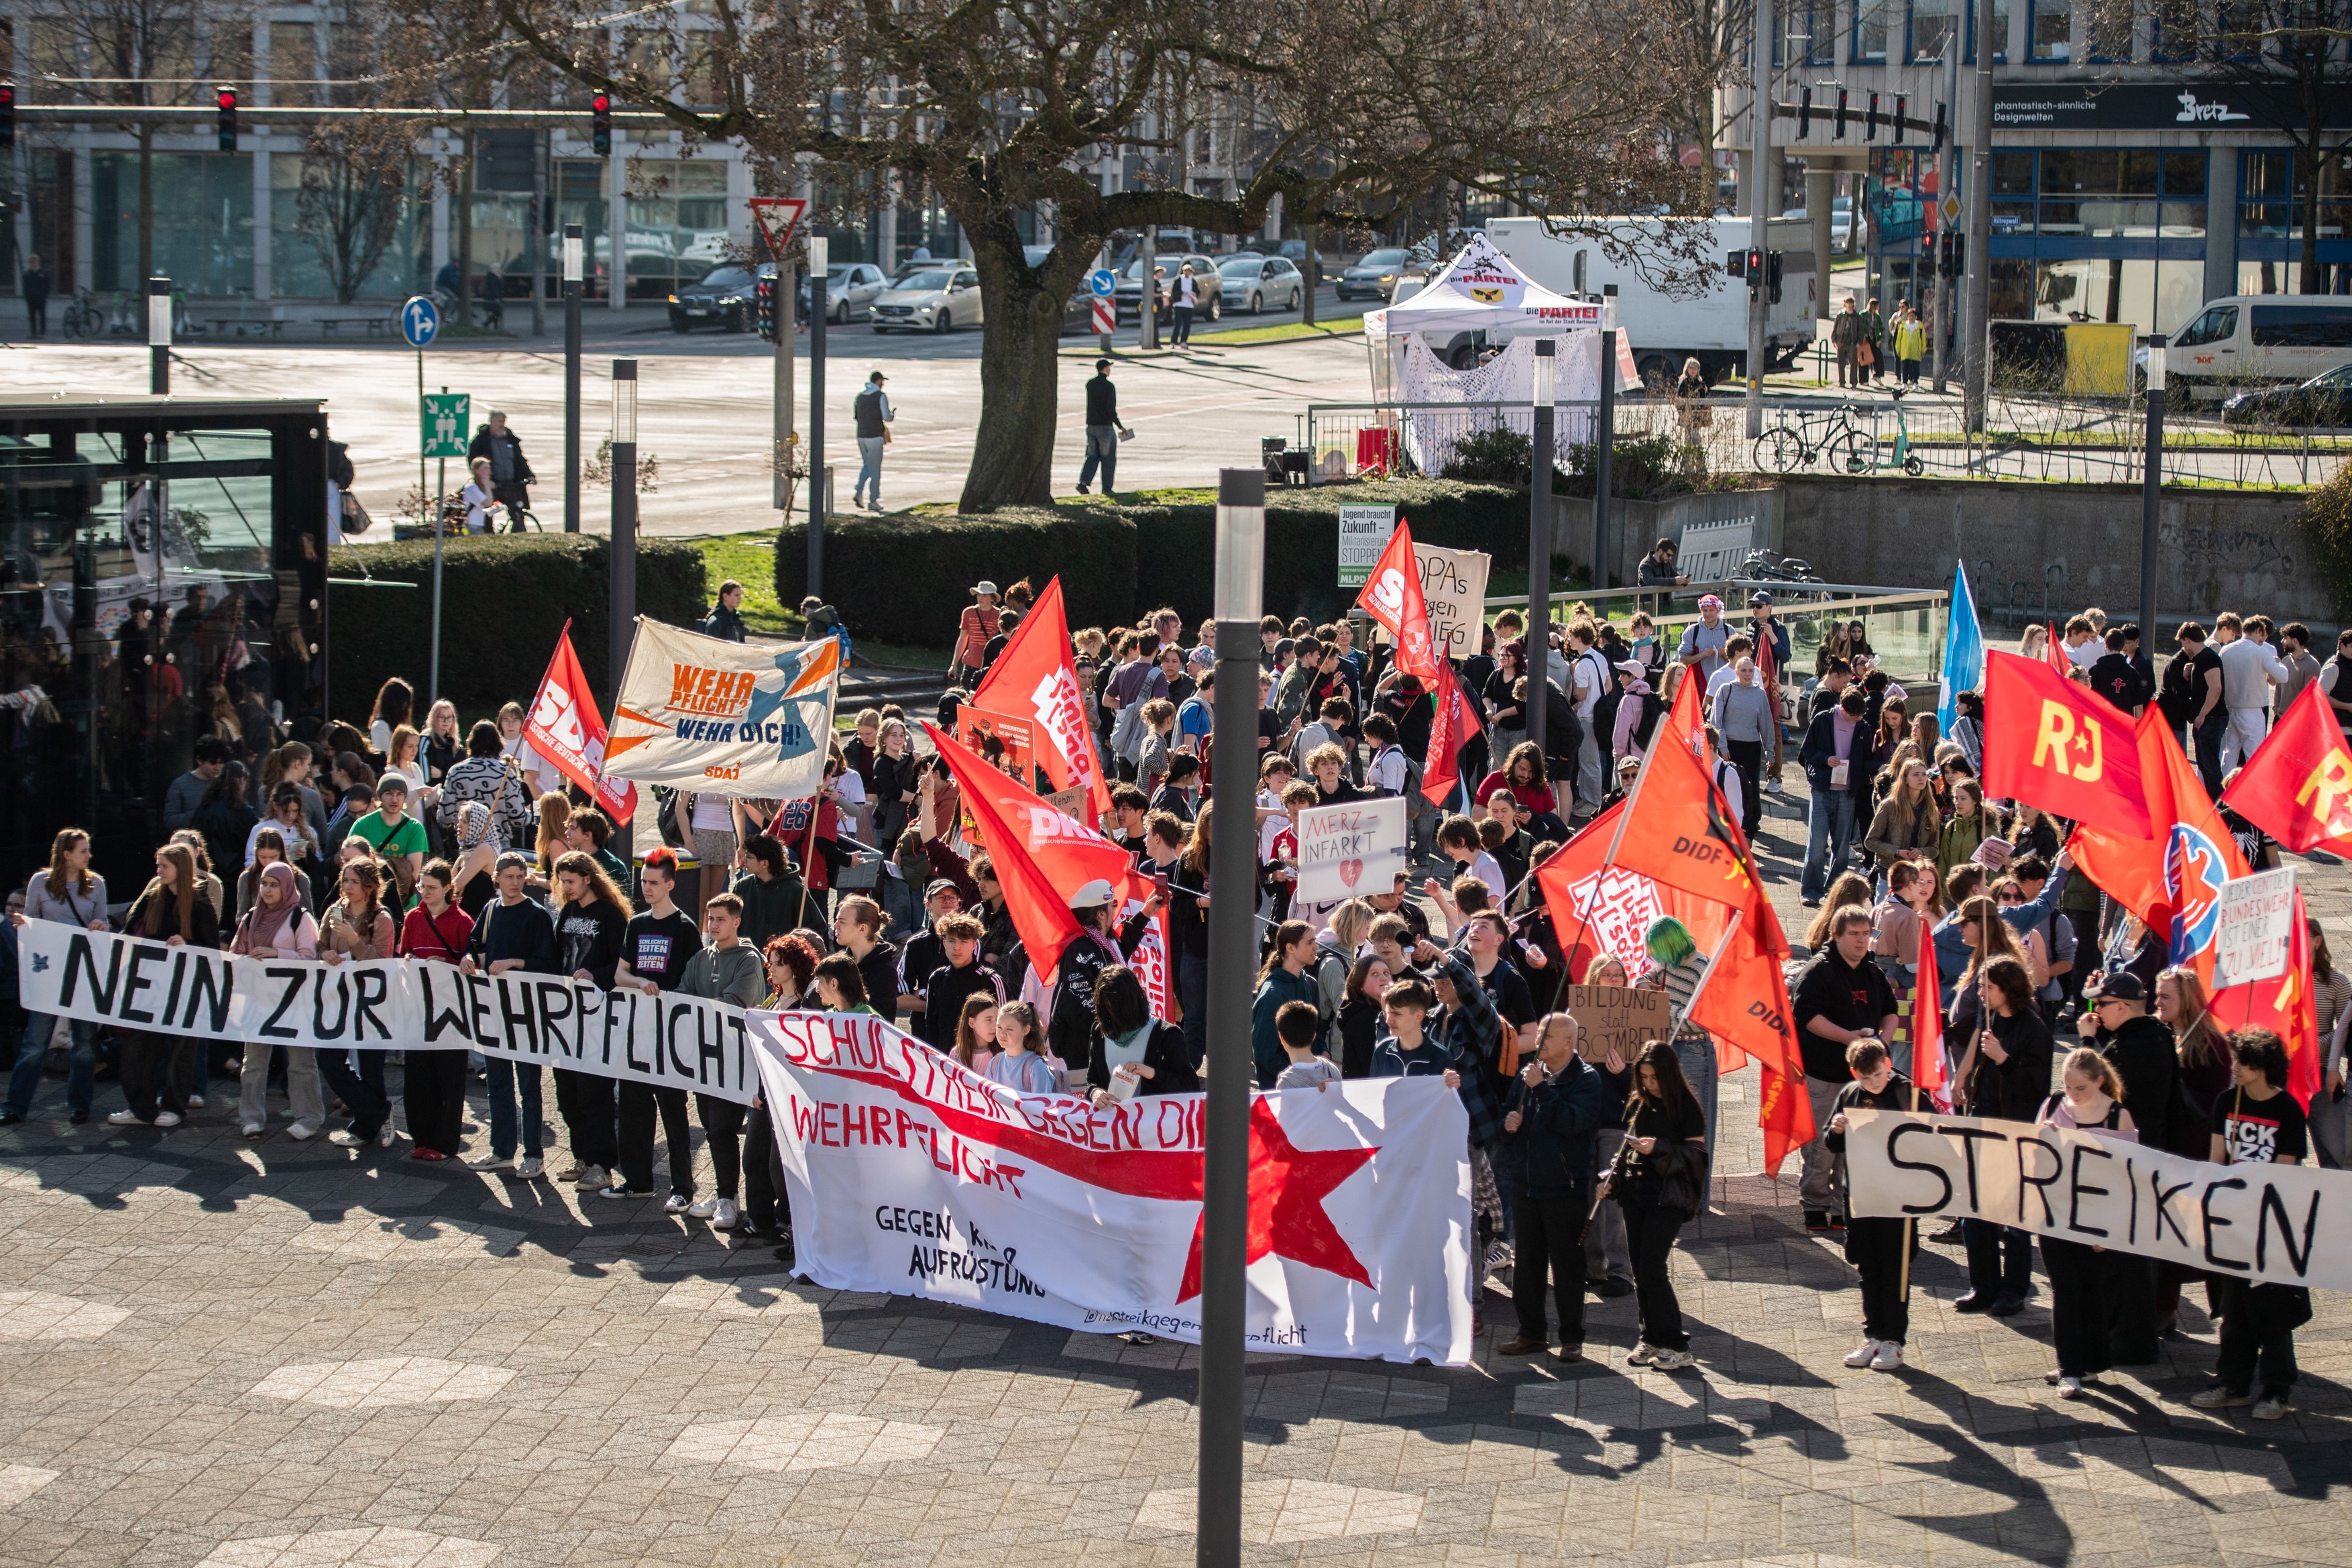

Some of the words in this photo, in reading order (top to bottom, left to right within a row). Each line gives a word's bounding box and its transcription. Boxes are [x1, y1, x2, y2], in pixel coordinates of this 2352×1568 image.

[1995, 101, 2096, 111] phantastisch-sinnliche
[2176, 89, 2250, 121] Bretz
[1995, 113, 2053, 123] Designwelten
[1463, 276, 1518, 286] PARTEI
[1526, 307, 1539, 315] Die
[1540, 307, 1598, 319] PARTEI
[1343, 510, 1365, 519] Jugend
[1366, 509, 1391, 519] braucht
[1343, 520, 1377, 533] Zukunft
[1341, 575, 1367, 584] MLPD
[674, 663, 756, 699] WEHR
[669, 691, 748, 714] PFLICHT?
[676, 718, 735, 742] WEHR
[998, 723, 1029, 734] WIDERSTAND
[1009, 739, 1029, 748] AUSWEG
[554, 743, 586, 772] DEUTSCHE
[704, 766, 740, 780] SDAJ
[781, 801, 811, 830] 26
[1061, 839, 1104, 848] Kommunistische
[1305, 831, 1376, 863] INFARKT
[2225, 881, 2252, 903] JEDER
[2274, 871, 2290, 890] DER
[2224, 925, 2241, 948] IST
[2243, 916, 2270, 942] EINER
[638, 944, 667, 954] ZEITEN
[637, 961, 664, 969] ZEITEN
[2223, 949, 2242, 979] ZU
[1576, 987, 1658, 1011] BILDUNG
[59, 934, 233, 1033] NEIN
[259, 968, 392, 1041] ZUR
[419, 967, 748, 1091] WEHRPFLICHT
[1600, 1009, 1631, 1028] statt
[779, 1012, 1011, 1121] SCHULSTREIK
[1014, 1097, 1143, 1151] GEGEN
[2225, 1119, 2279, 1147] FCK
[791, 1095, 1025, 1200] WEHRPFLICHT
[1887, 1122, 2320, 1277] STREIKEN
[875, 1205, 951, 1243] GEGEN
